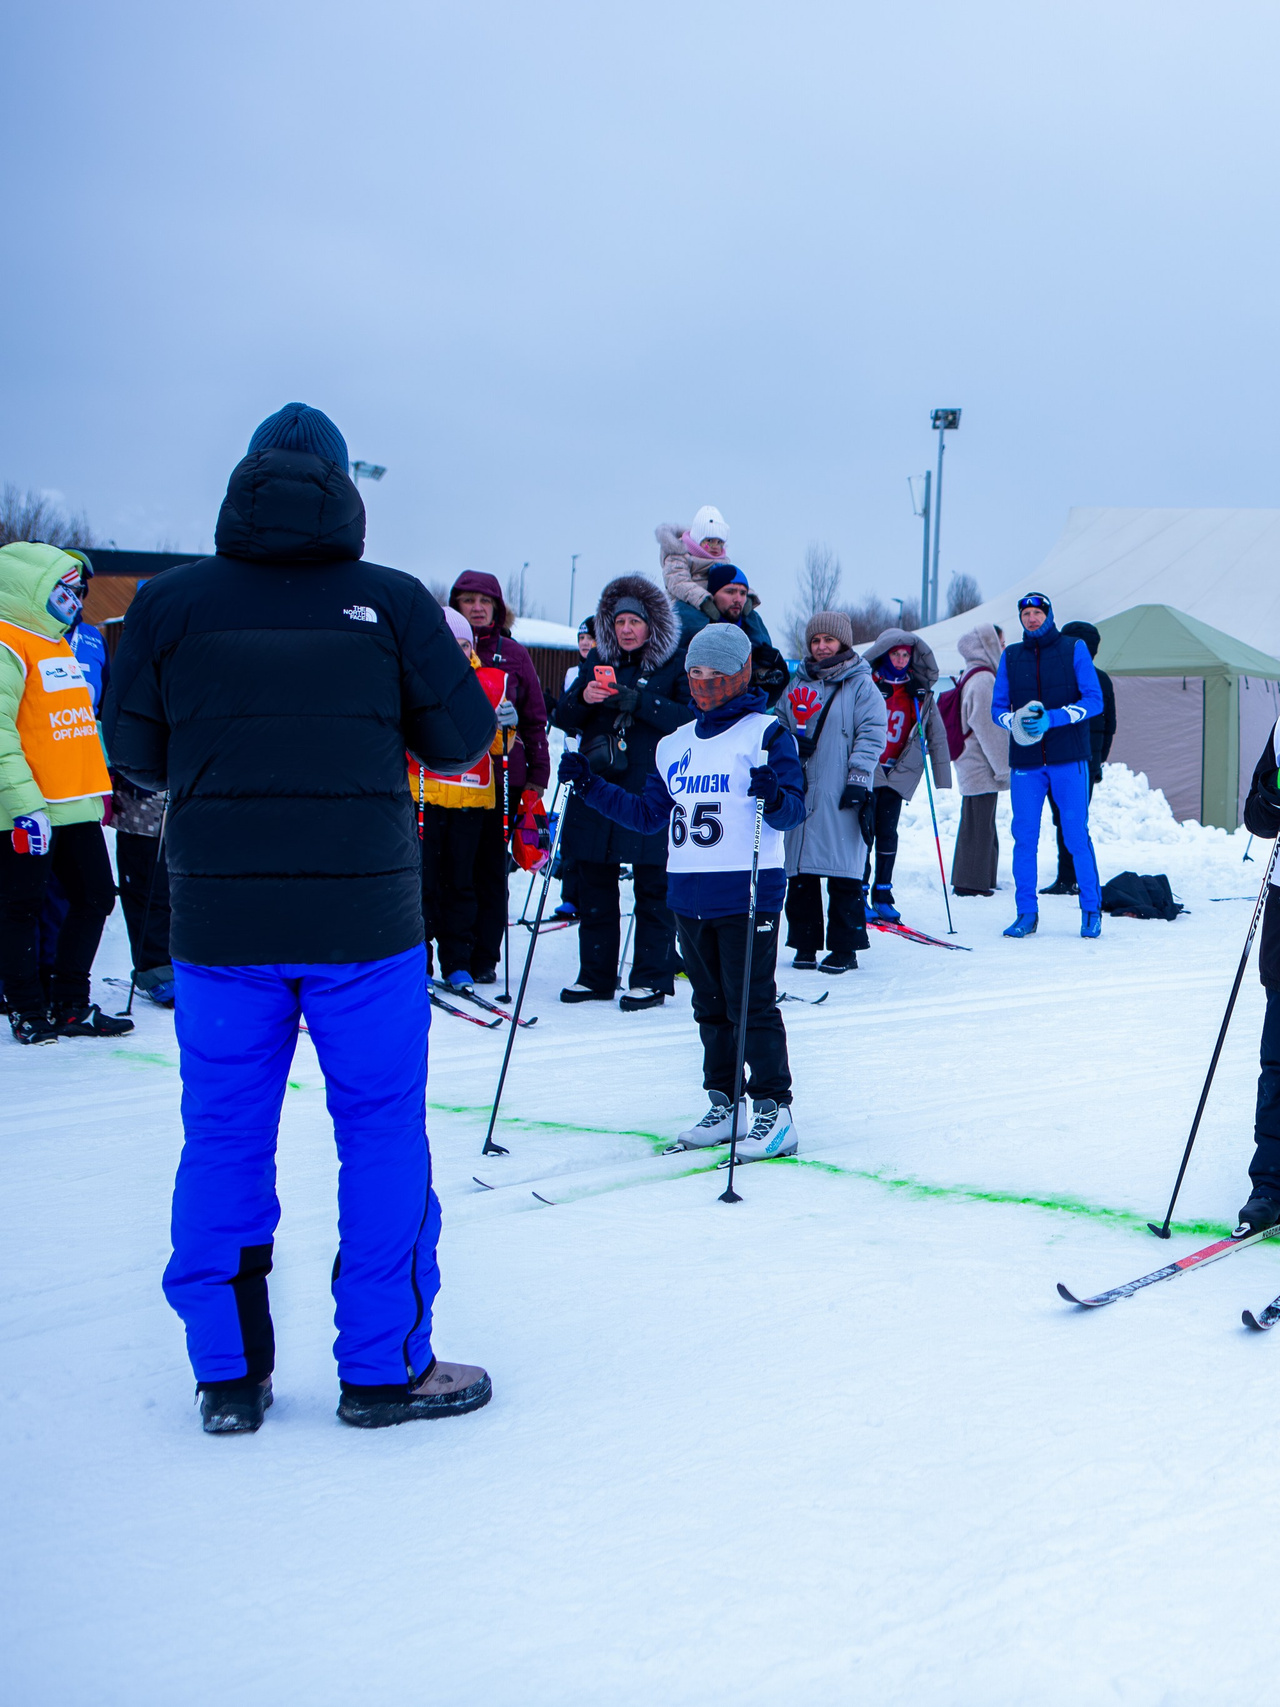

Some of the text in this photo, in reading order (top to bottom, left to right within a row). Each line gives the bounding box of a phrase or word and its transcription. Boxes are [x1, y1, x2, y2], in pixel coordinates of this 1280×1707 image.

[343, 609, 366, 617] NORTH
[885, 710, 905, 743] 3
[686, 774, 730, 794] МОЭК
[503, 829, 508, 842] A7
[671, 801, 724, 848] 65
[754, 815, 762, 850] NORDWAY
